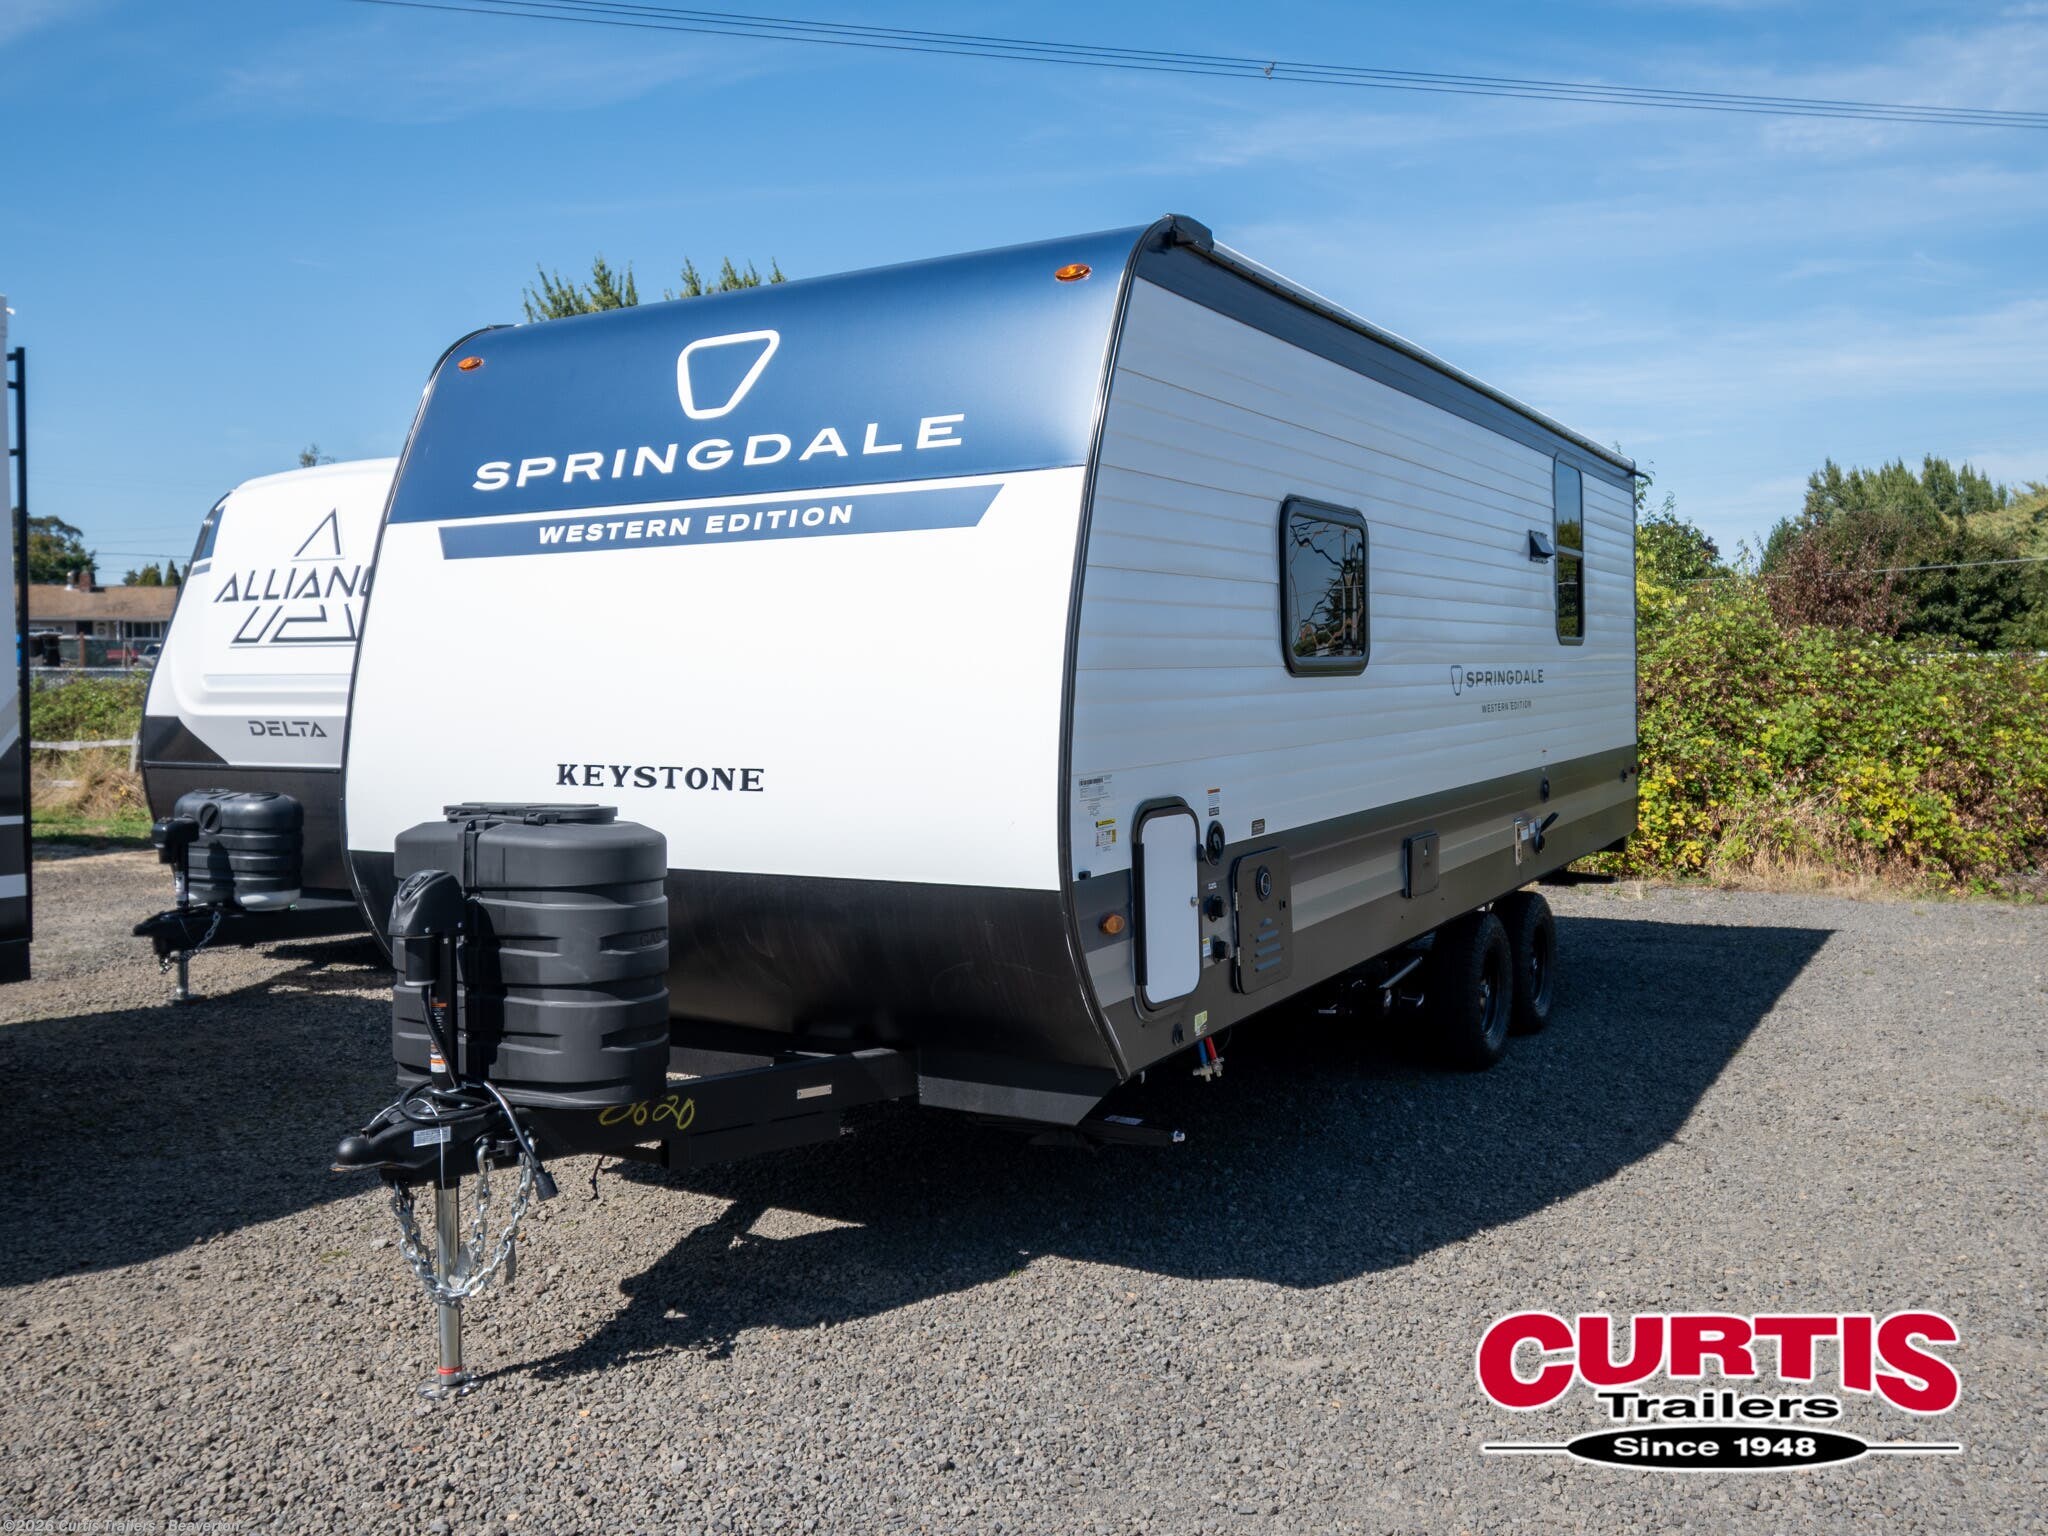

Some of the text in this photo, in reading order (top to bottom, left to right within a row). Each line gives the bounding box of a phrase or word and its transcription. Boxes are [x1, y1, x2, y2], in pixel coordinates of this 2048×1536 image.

[472, 413, 965, 491] SPRINGDALE
[538, 504, 853, 544] WESTERN EDITION
[1466, 669, 1544, 688] SPRINGDALE
[1481, 700, 1532, 714] WESTERN EDITION
[248, 720, 328, 738] DELTA
[556, 763, 765, 792] KEYSTONE
